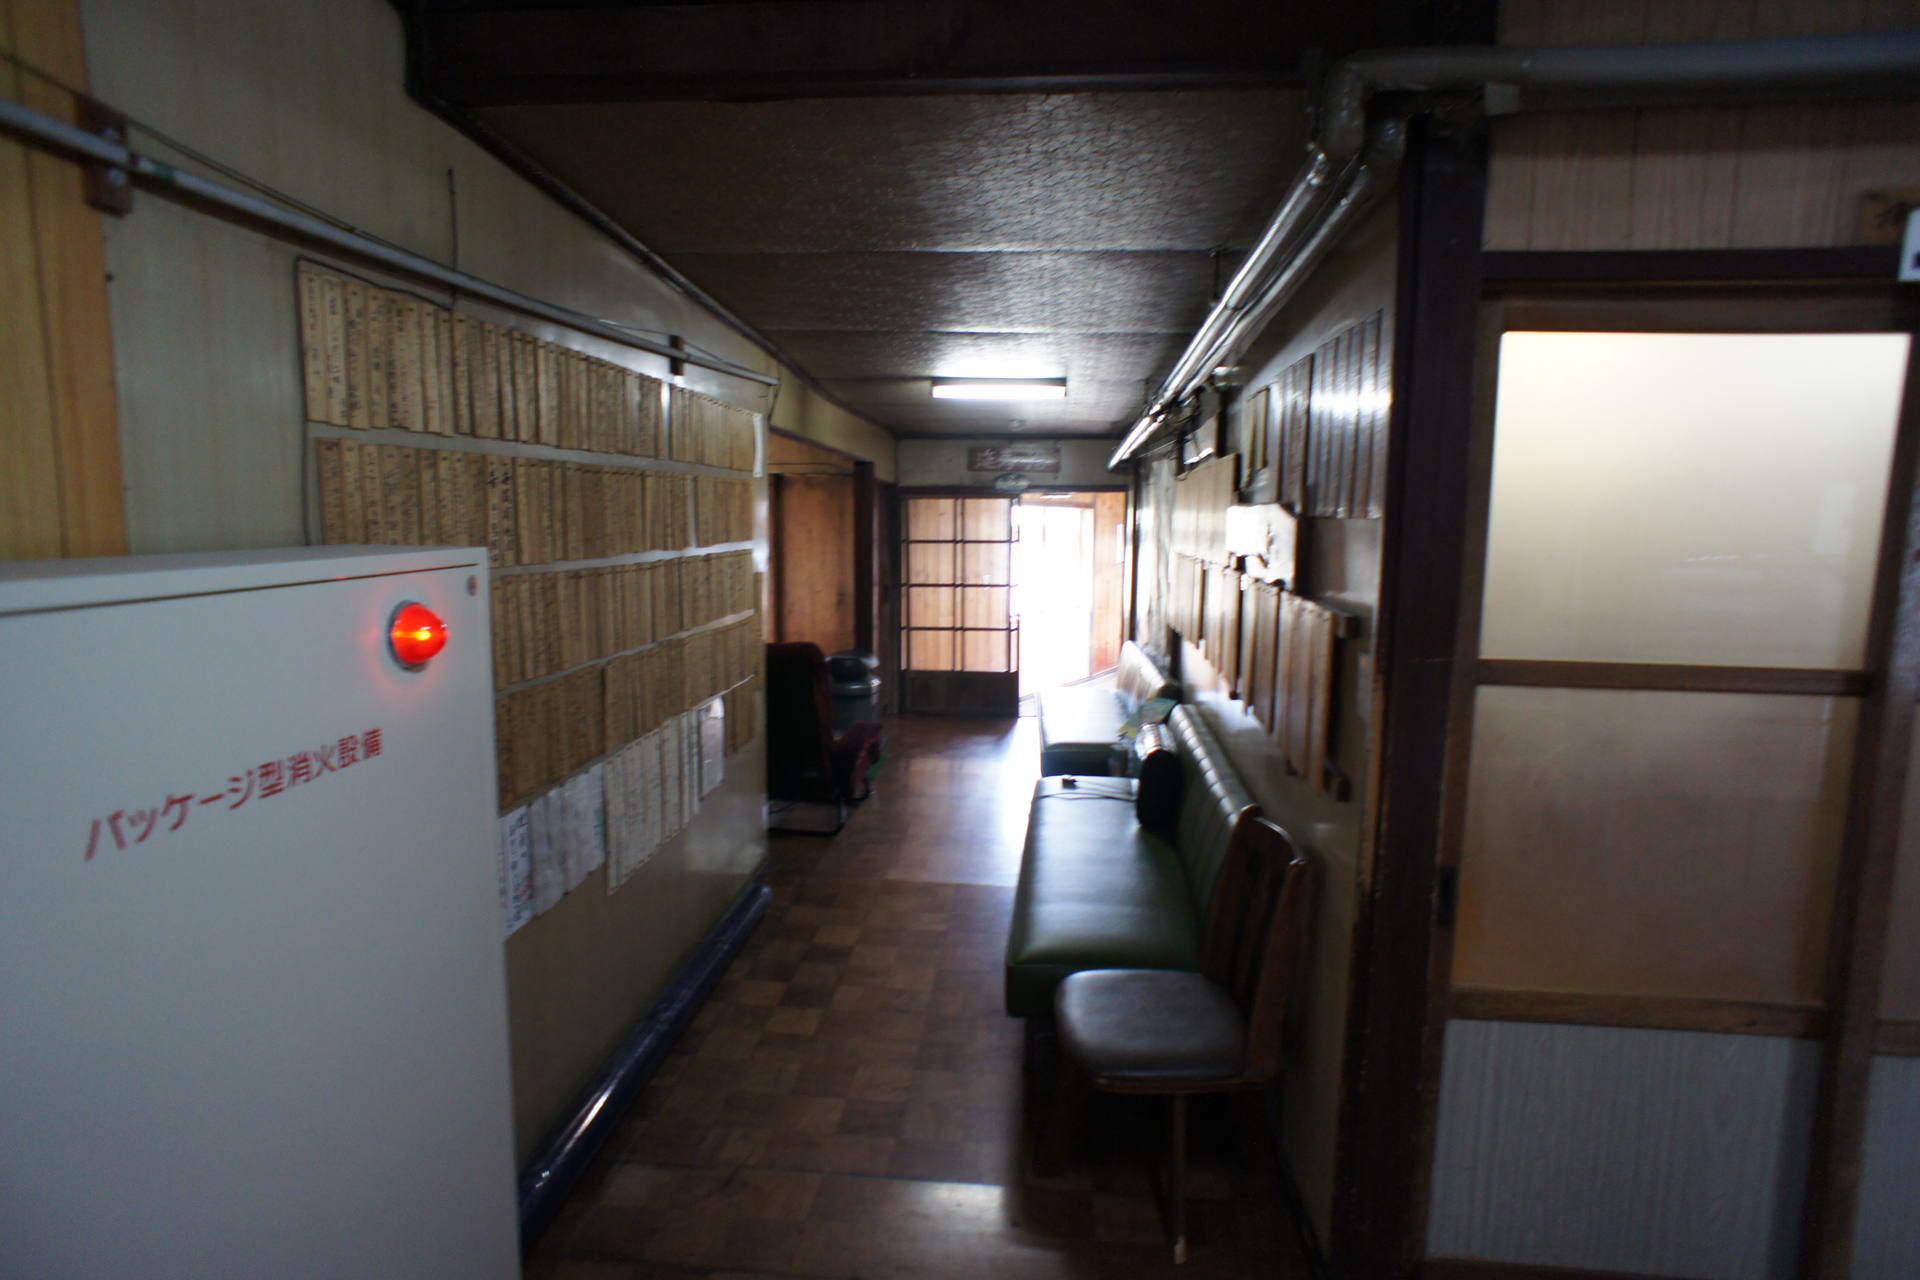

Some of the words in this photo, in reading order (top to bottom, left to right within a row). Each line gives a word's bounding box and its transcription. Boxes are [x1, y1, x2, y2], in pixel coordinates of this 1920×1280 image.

[84, 728, 382, 861] パッケージ型消火設備
